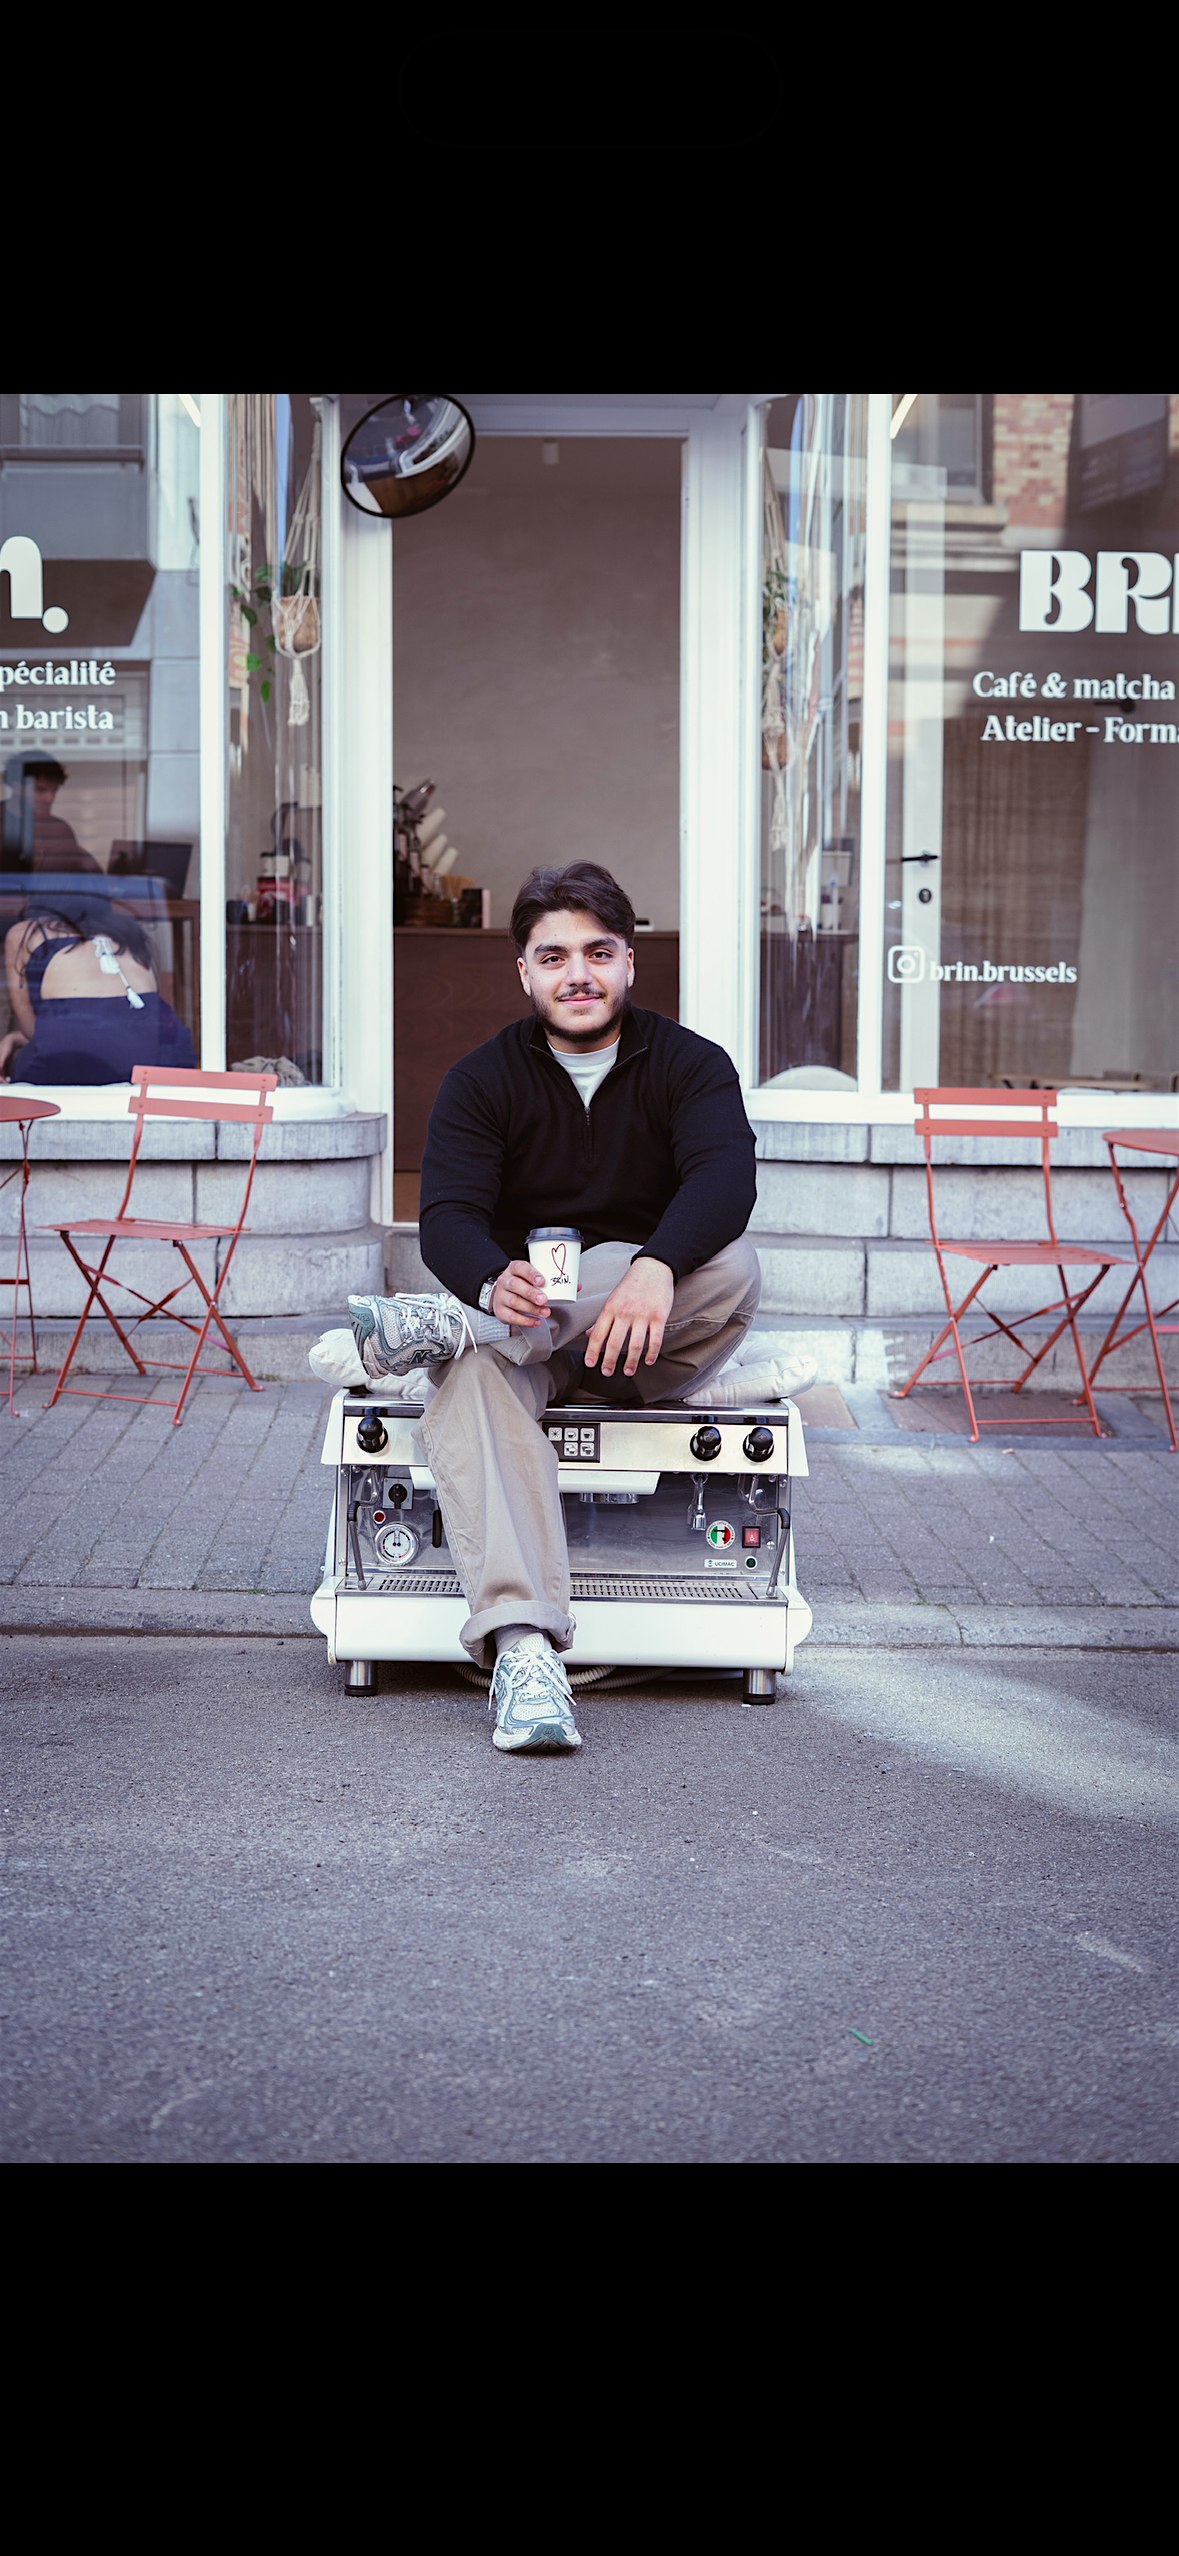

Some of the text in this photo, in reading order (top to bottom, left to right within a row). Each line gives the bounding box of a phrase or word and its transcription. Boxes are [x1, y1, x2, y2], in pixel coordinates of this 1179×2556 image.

[1019, 550, 1179, 635] BR
[972, 671, 1176, 700] Café & matcha
[16, 704, 114, 730] barista
[980, 715, 1082, 742] Atelier
[1103, 717, 1179, 743] Form
[930, 960, 1077, 983] brin.brussels
